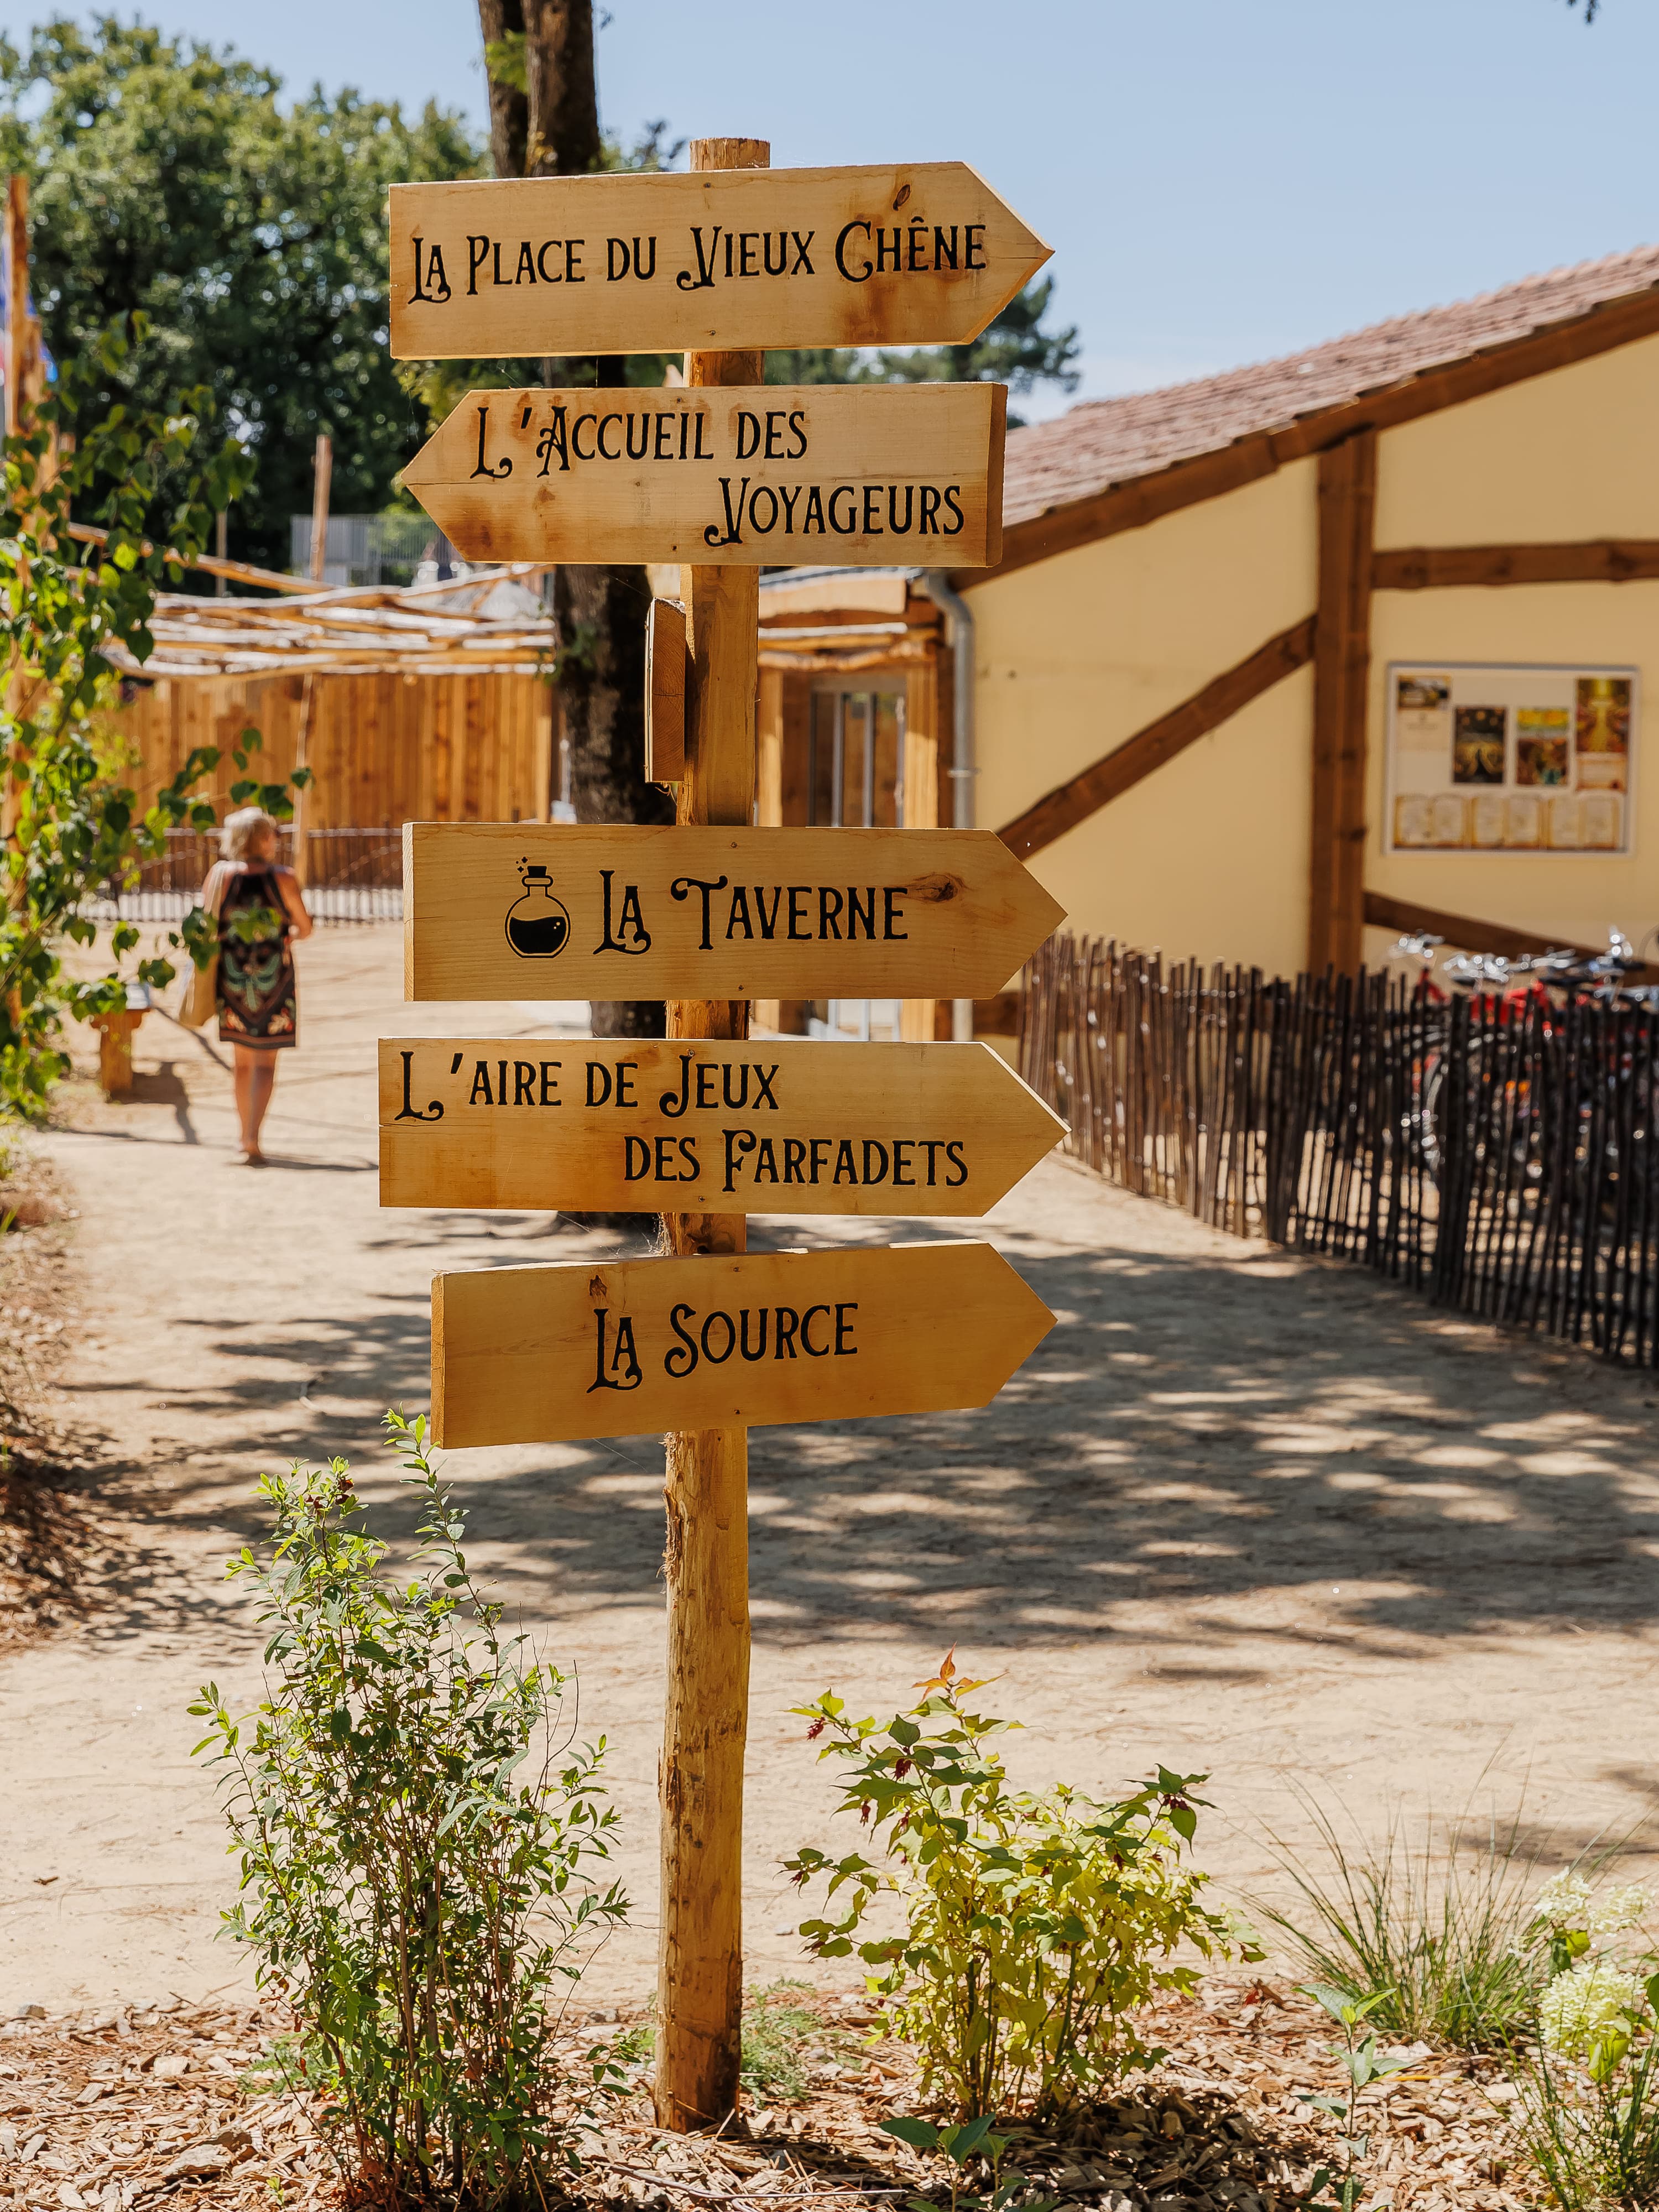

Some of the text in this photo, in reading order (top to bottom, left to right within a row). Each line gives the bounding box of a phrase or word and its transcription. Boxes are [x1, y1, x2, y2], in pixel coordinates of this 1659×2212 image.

[407, 216, 987, 305] LA PLACE DU VIEUX CHÊNE
[469, 405, 808, 479] L'ACCUEIL DES
[703, 476, 965, 547] VOYAGEURS
[592, 869, 909, 956] LA TAVERNE
[394, 1051, 780, 1122] L'AIRE DE JEUX
[623, 1128, 969, 1193] DES FARFADETS
[586, 1302, 859, 1394] LA SOURCE
